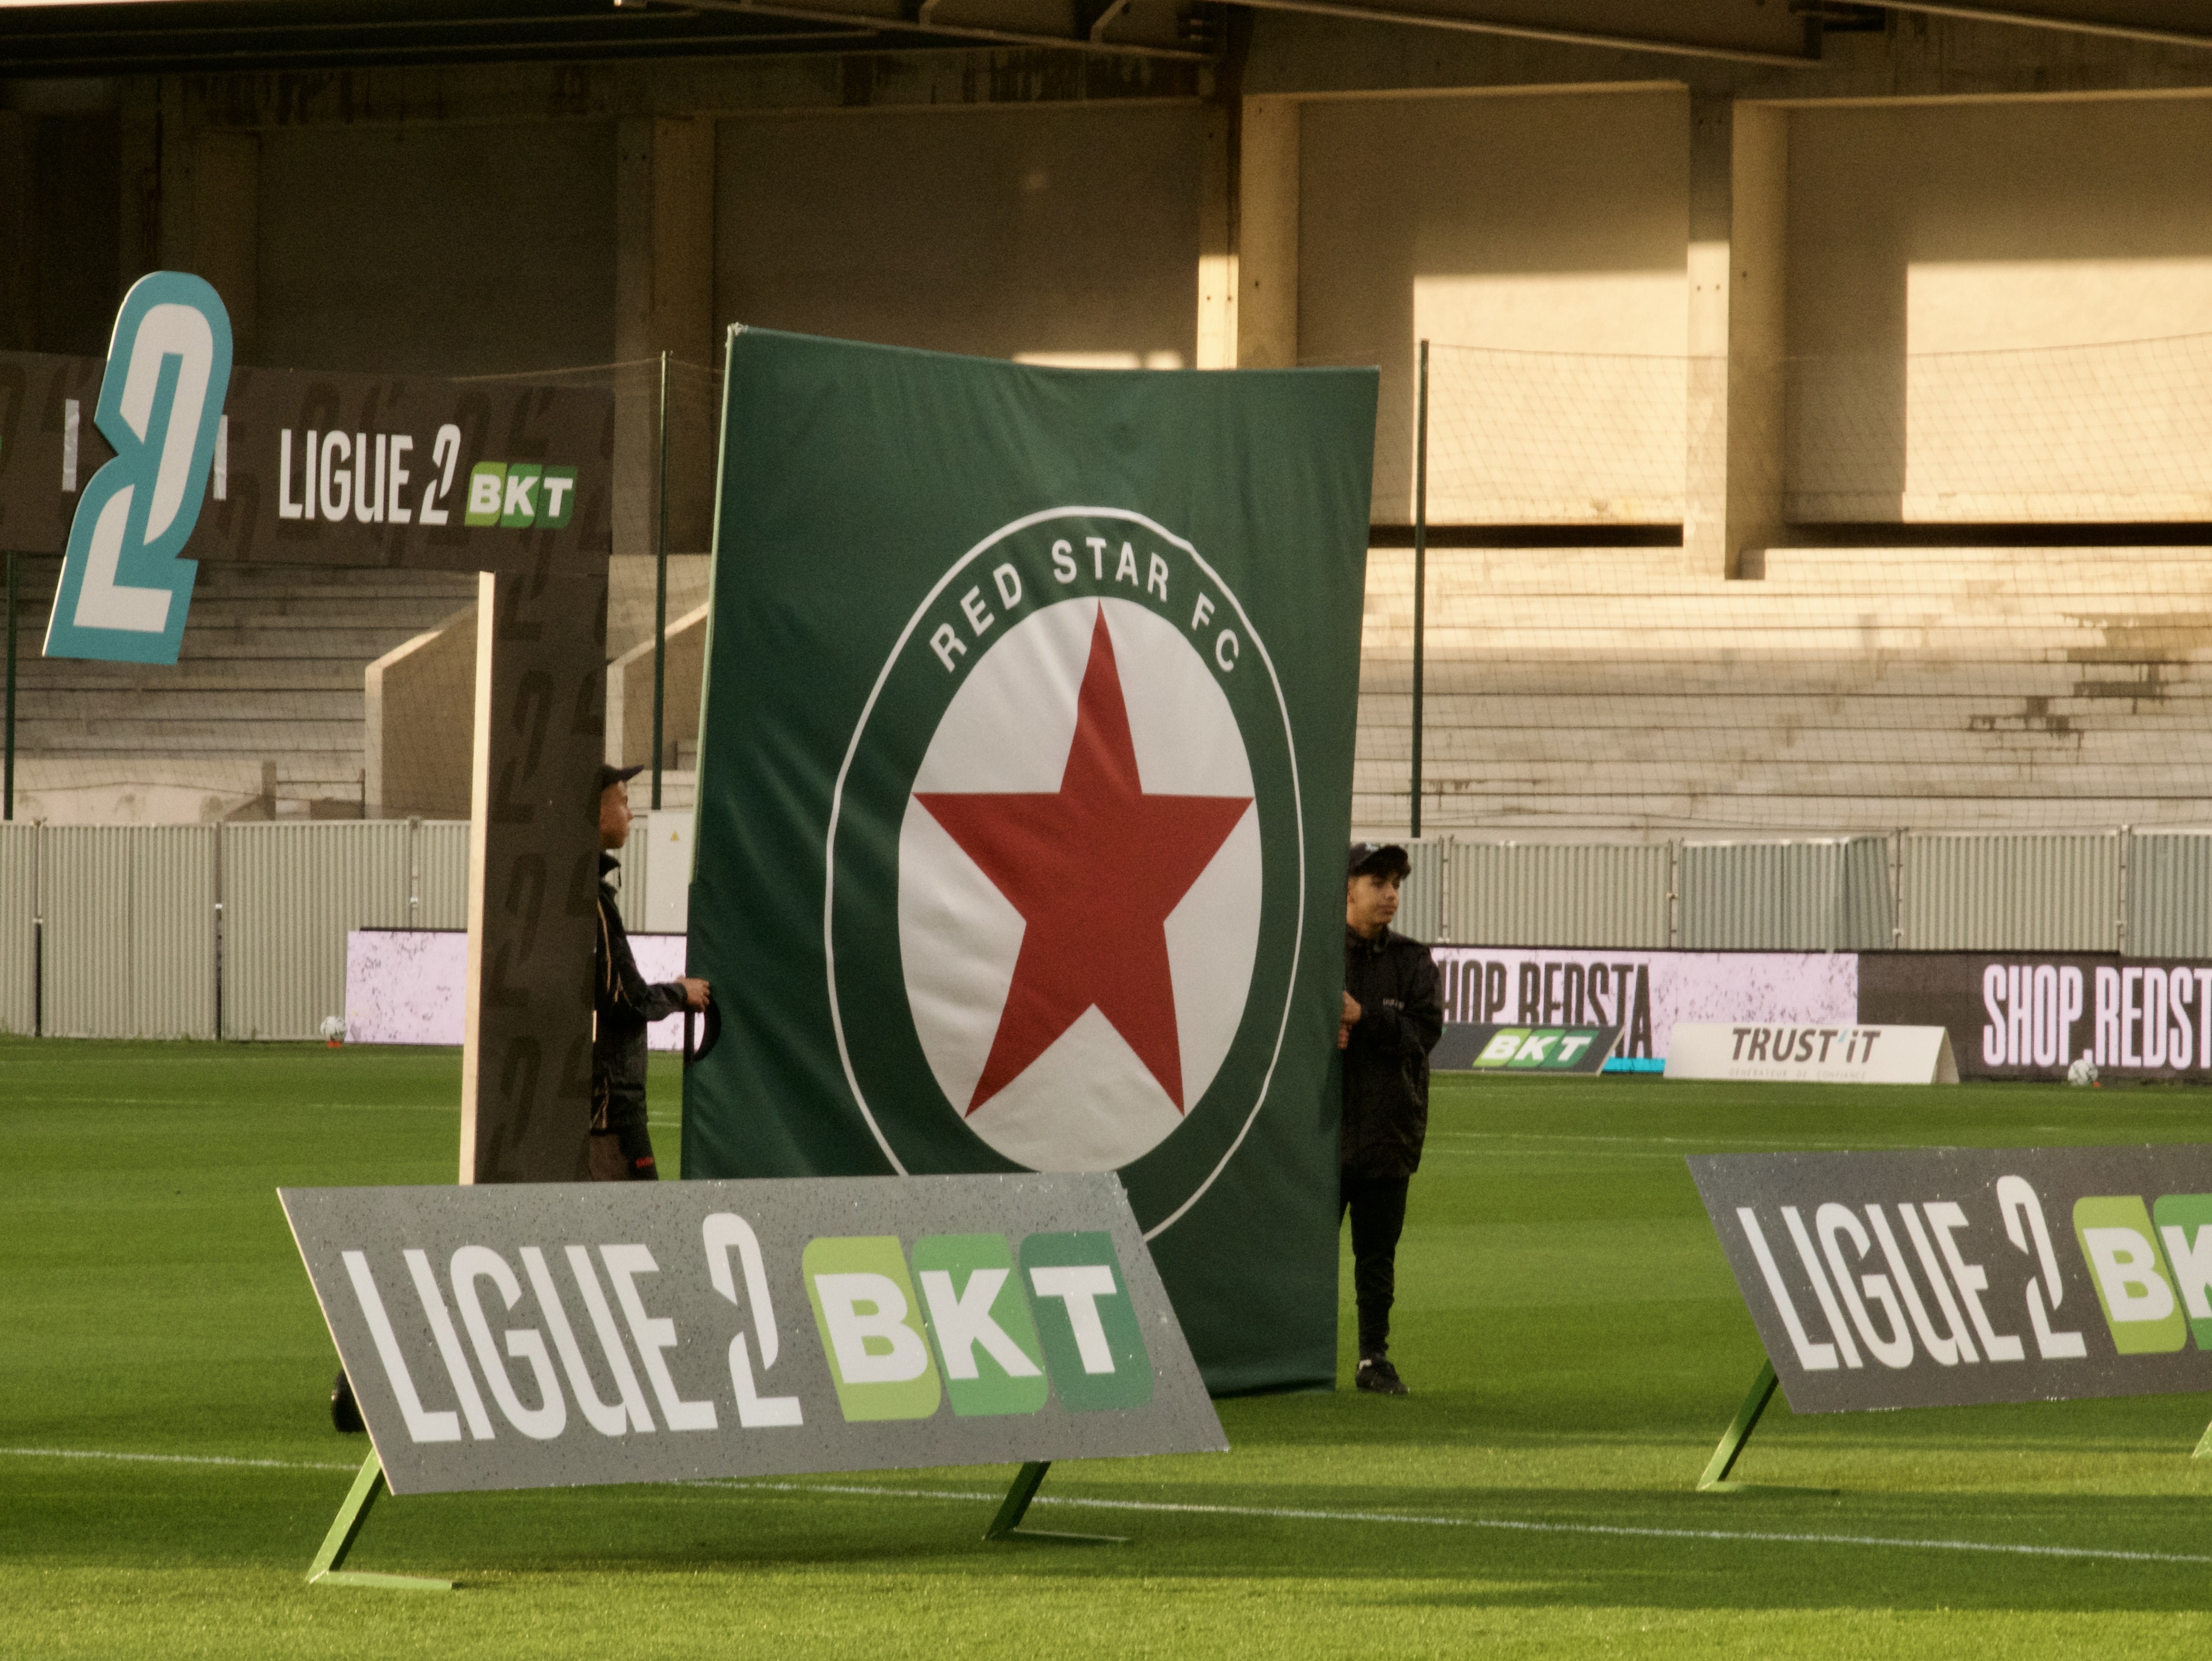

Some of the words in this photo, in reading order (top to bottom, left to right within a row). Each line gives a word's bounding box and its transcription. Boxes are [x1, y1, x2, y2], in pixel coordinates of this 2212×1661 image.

[72, 303, 213, 633] 2
[279, 428, 413, 523] LIGUE
[419, 423, 461, 526] 2
[469, 474, 573, 517] BKT
[930, 563, 1022, 672] RED
[1052, 537, 1169, 602] STAR
[1191, 593, 1239, 672] FC
[1438, 960, 1507, 1023] HOP
[1482, 1035, 1592, 1062] BKT
[342, 1244, 718, 1443] LIGUE
[702, 1213, 803, 1428] 2
[814, 1265, 1117, 1384] BKT
[1736, 1201, 2025, 1371] LIGUE
[1996, 1175, 2087, 1360] 2
